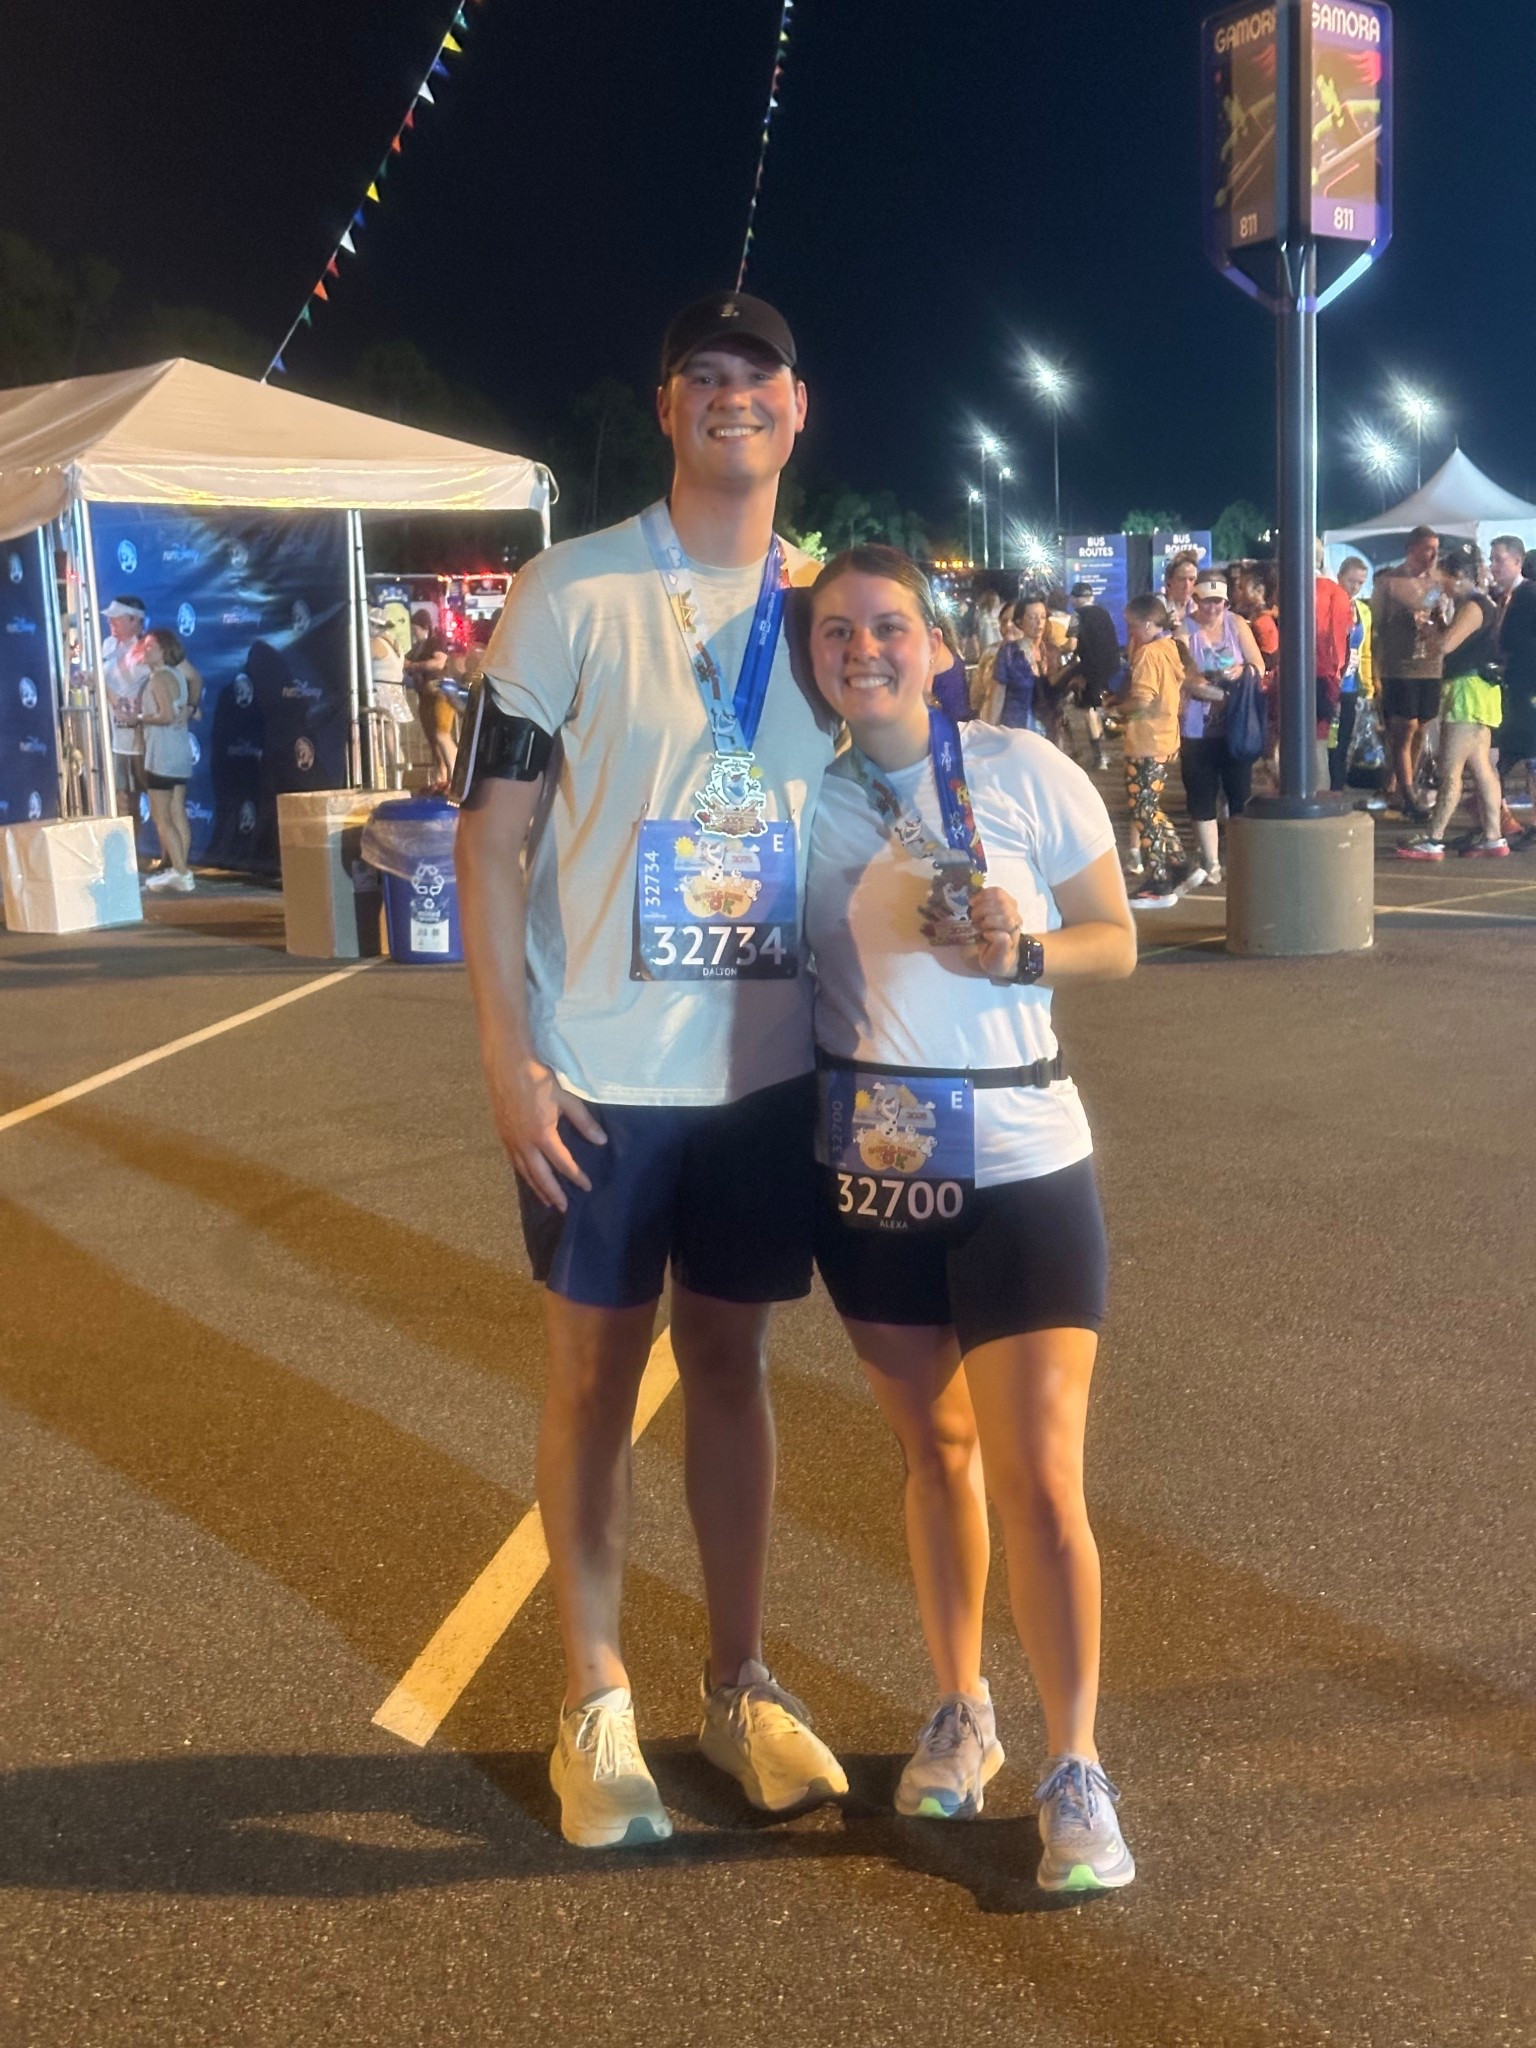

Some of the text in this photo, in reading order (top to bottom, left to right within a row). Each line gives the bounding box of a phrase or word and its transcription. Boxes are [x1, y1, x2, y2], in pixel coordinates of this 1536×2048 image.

[1240, 213, 1258, 238] 811
[1334, 207, 1354, 232] 811
[1087, 537, 1105, 546] BUS
[1173, 534, 1191, 543] BUS
[1079, 547, 1114, 557] ROUTES
[773, 834, 785, 853] E
[644, 850, 661, 907] 32734
[652, 926, 788, 966] 32734
[702, 967, 738, 977] DALTON
[951, 1091, 964, 1110] E
[837, 1173, 964, 1220] 32700
[879, 1219, 909, 1230] ALEXA
